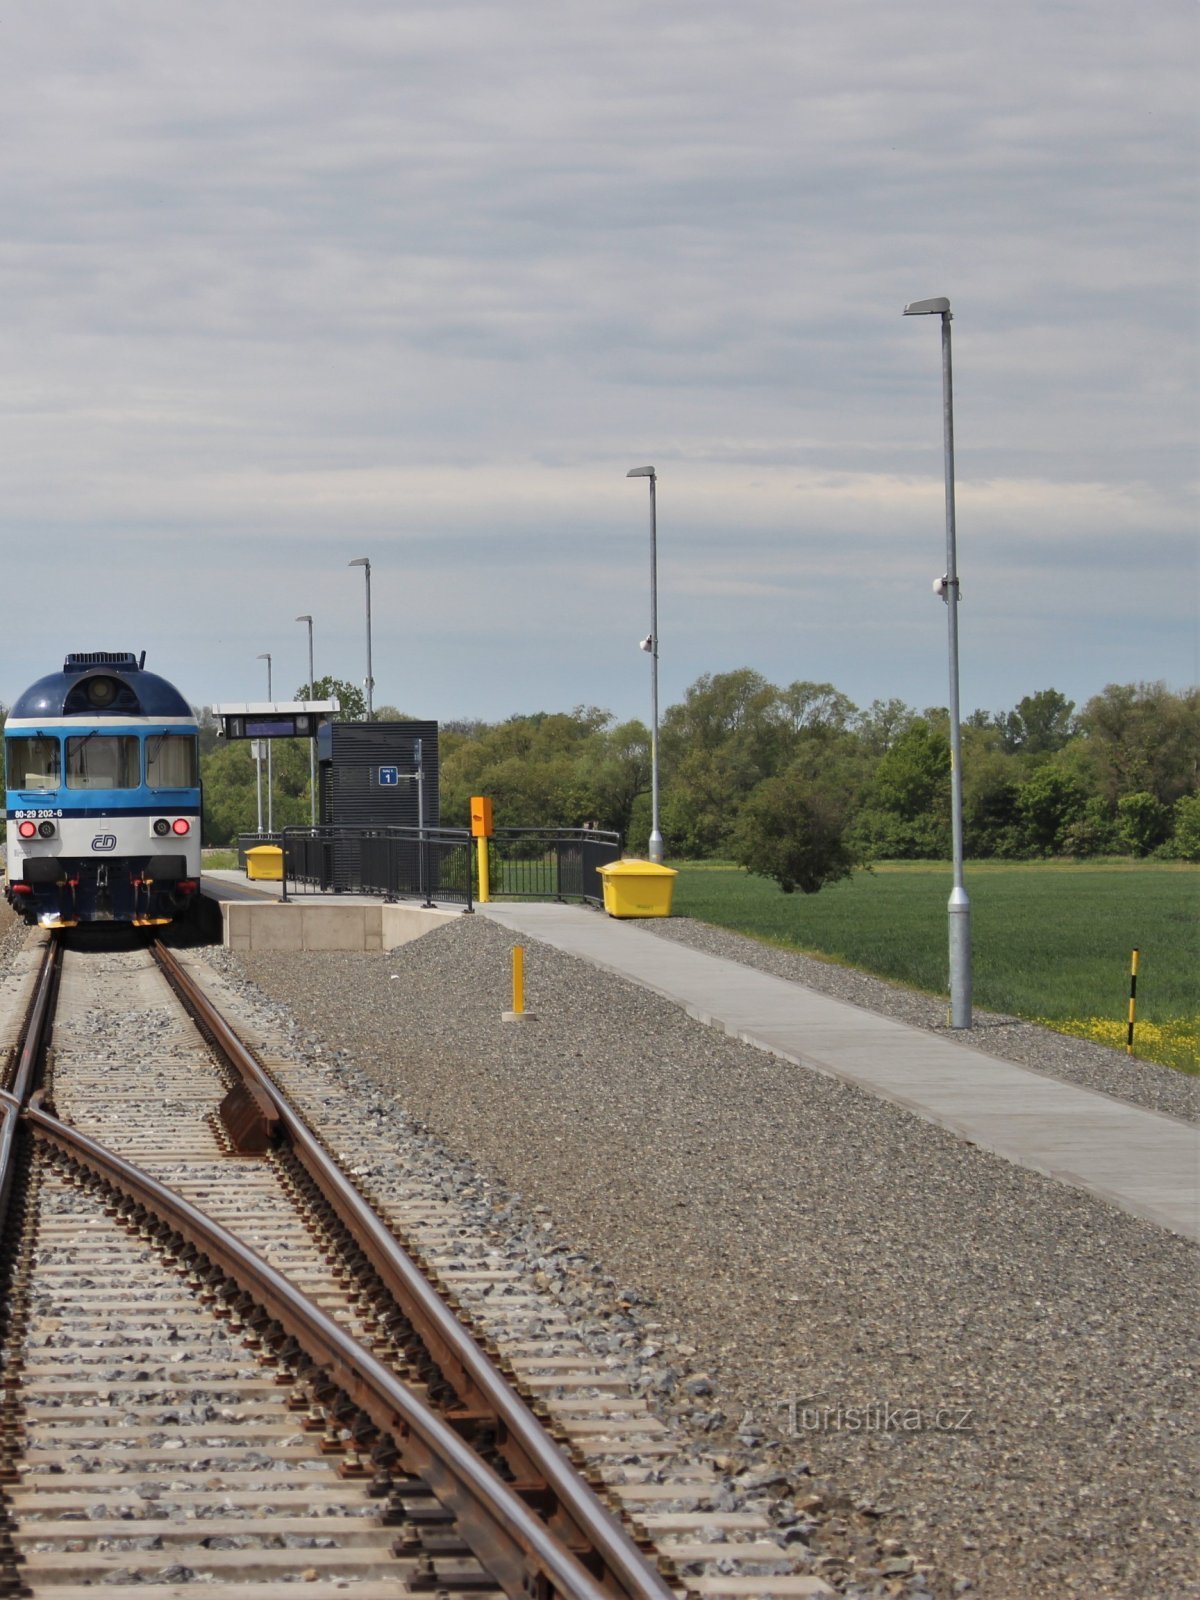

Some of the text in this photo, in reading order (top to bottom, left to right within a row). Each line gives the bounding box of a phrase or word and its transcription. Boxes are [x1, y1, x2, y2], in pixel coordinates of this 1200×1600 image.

[385, 774, 390, 783] 1
[15, 809, 63, 818] 80-29 202-6
